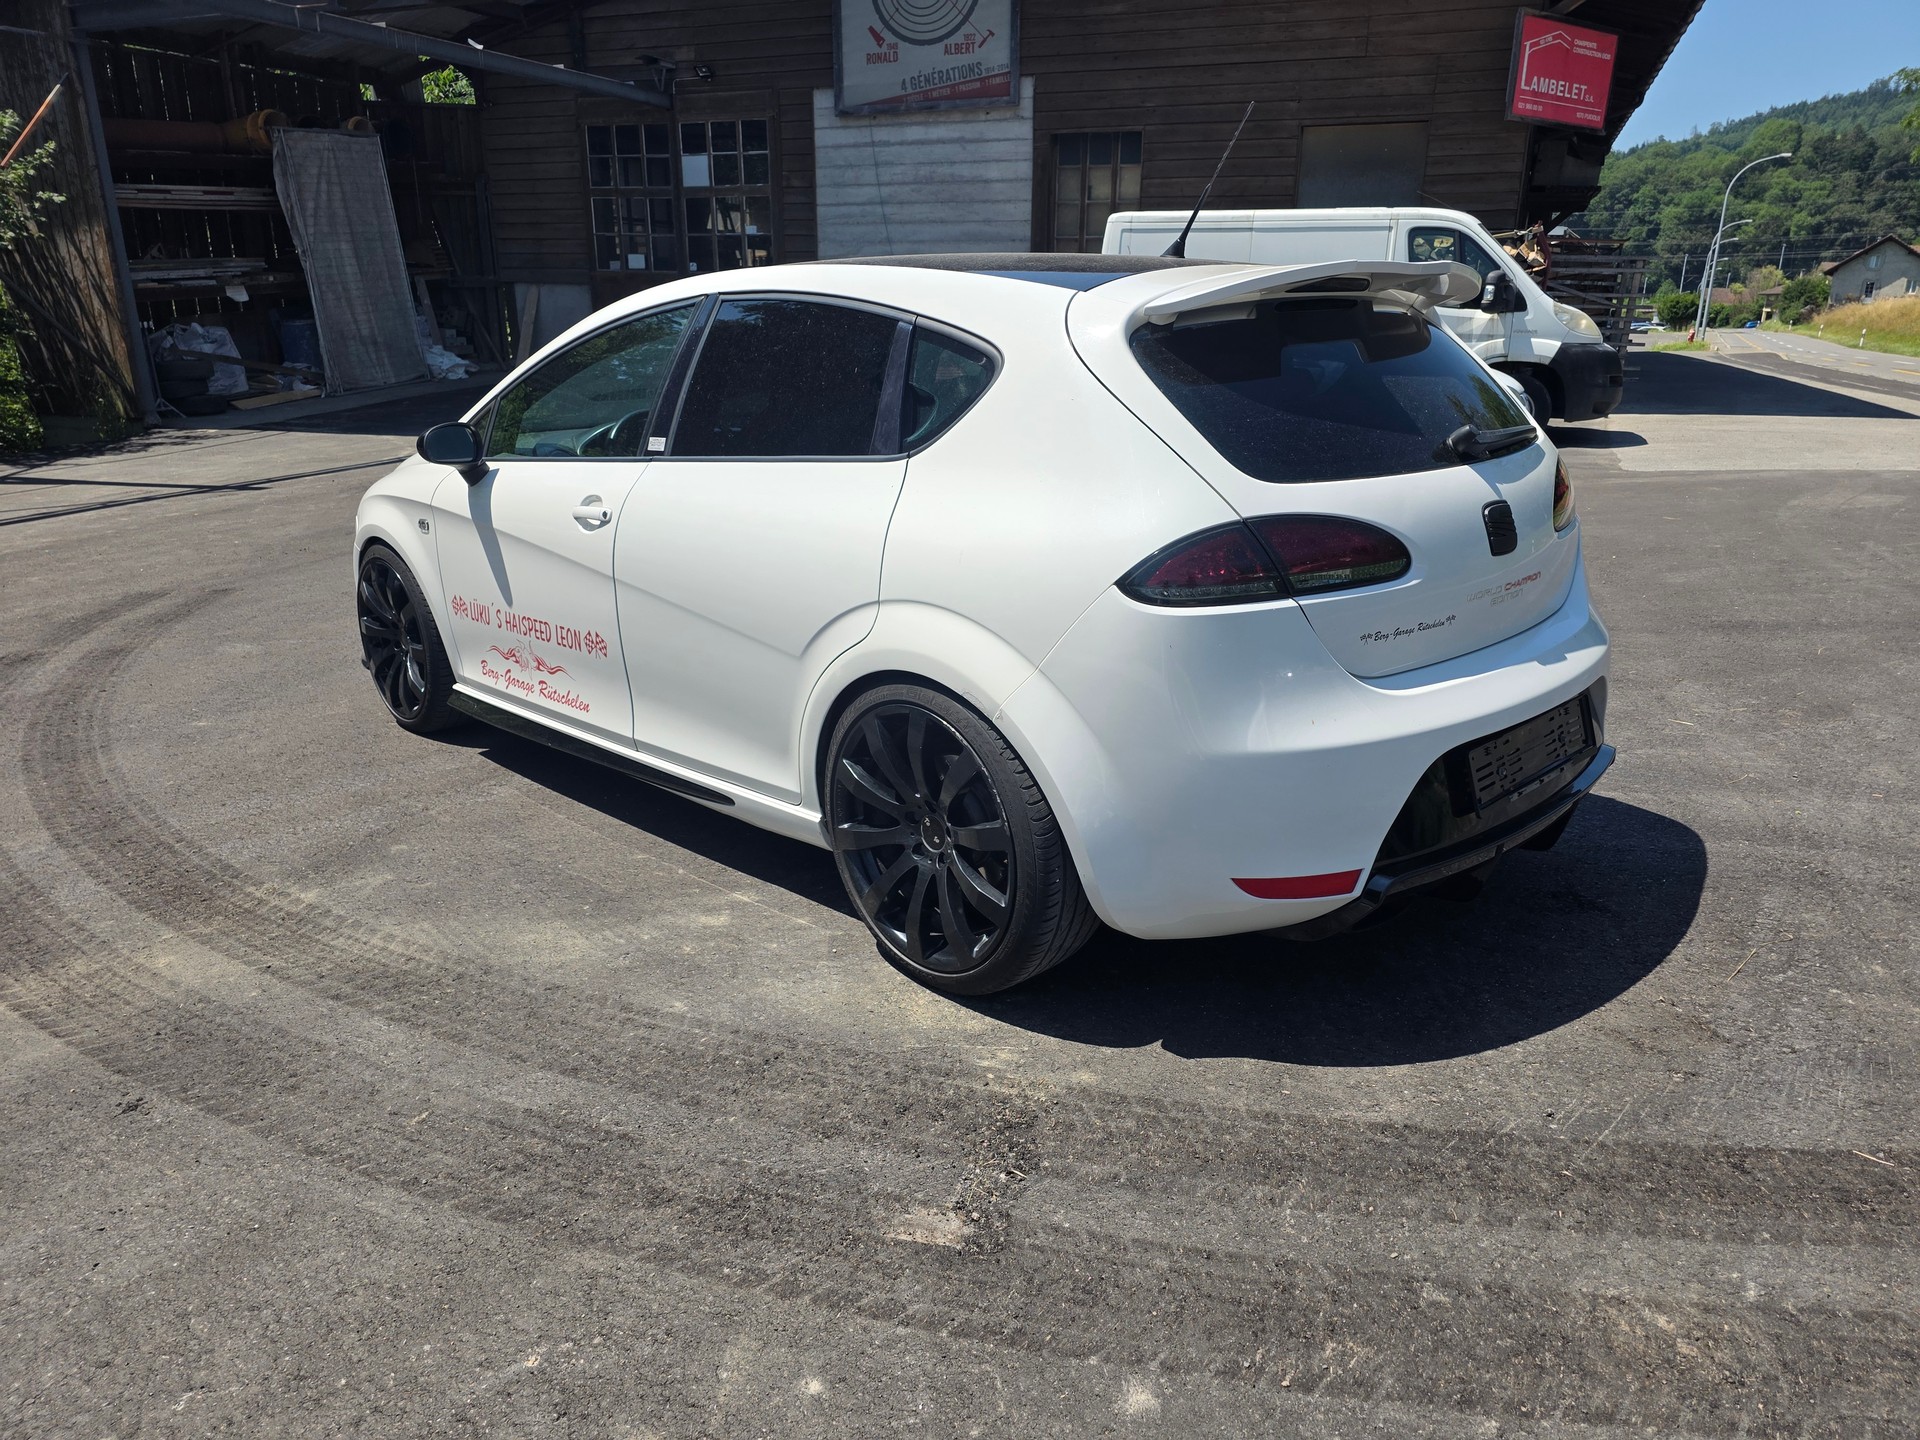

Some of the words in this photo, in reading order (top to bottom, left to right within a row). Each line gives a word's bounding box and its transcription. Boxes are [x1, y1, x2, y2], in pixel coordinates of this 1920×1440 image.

[866, 51, 898, 65] RONALD
[943, 42, 976, 56] ALBERT
[901, 78, 908, 93] 4
[909, 61, 983, 91] GÉNÉRATIONS
[1466, 585, 1503, 602] WORLD
[1503, 571, 1542, 592] CHAMPION
[505, 611, 552, 643] HAISPEED
[555, 624, 582, 652] LEON
[1373, 625, 1416, 643] Berg-Garage
[480, 659, 535, 697] Berg-Garage
[538, 680, 591, 713] Rütschelen
